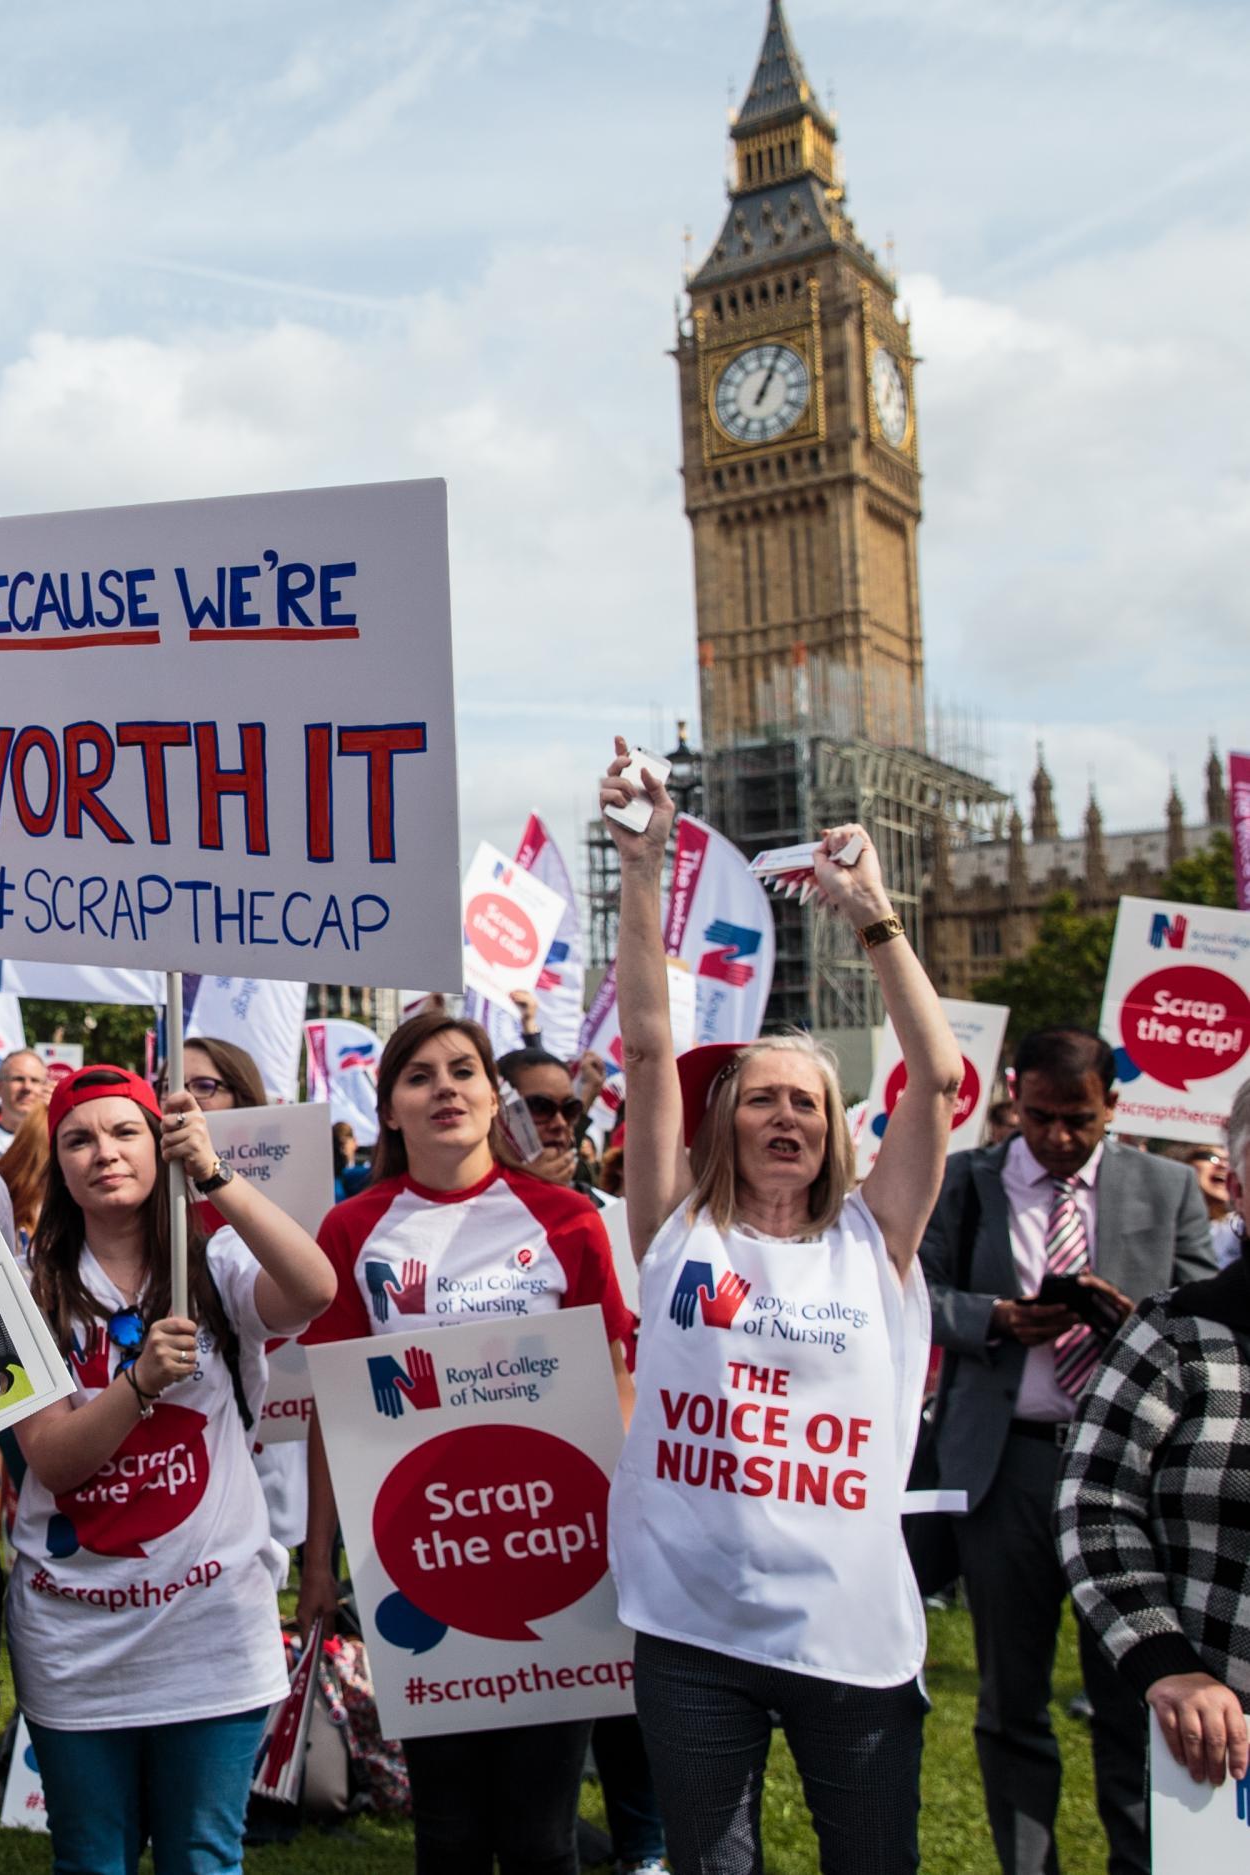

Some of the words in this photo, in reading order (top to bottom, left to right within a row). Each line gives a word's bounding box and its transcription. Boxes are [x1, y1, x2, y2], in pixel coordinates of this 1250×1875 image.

[174, 549, 358, 629] WE'RE
[304, 721, 427, 863] IT
[676, 849, 700, 888] The
[1153, 990, 1226, 1027] Scrap
[1137, 1017, 1183, 1045] the
[1187, 1027, 1242, 1055] cap!
[215, 1146, 235, 1161] yal
[238, 1142, 290, 1162] College
[236, 1164, 271, 1181] rsing
[437, 1276, 483, 1294] Royal
[487, 1275, 549, 1292] College
[436, 1298, 453, 1314] of
[460, 1297, 529, 1316] Nursing
[750, 1294, 796, 1321] Royal
[801, 1301, 869, 1328] College
[743, 1315, 767, 1336] of
[771, 1320, 847, 1353] Nursing
[446, 1363, 493, 1388] Royal
[496, 1356, 560, 1378] College
[727, 1361, 791, 1397] THE
[450, 1389, 469, 1407] of
[471, 1382, 540, 1403] Nursing
[659, 1388, 788, 1449] VOICE
[806, 1412, 872, 1458] OF
[656, 1440, 868, 1511] NURSING
[425, 1472, 554, 1524] Scrap
[412, 1527, 492, 1574] the
[504, 1509, 600, 1566] cap!
[405, 1659, 635, 1706] #scrapthecap
